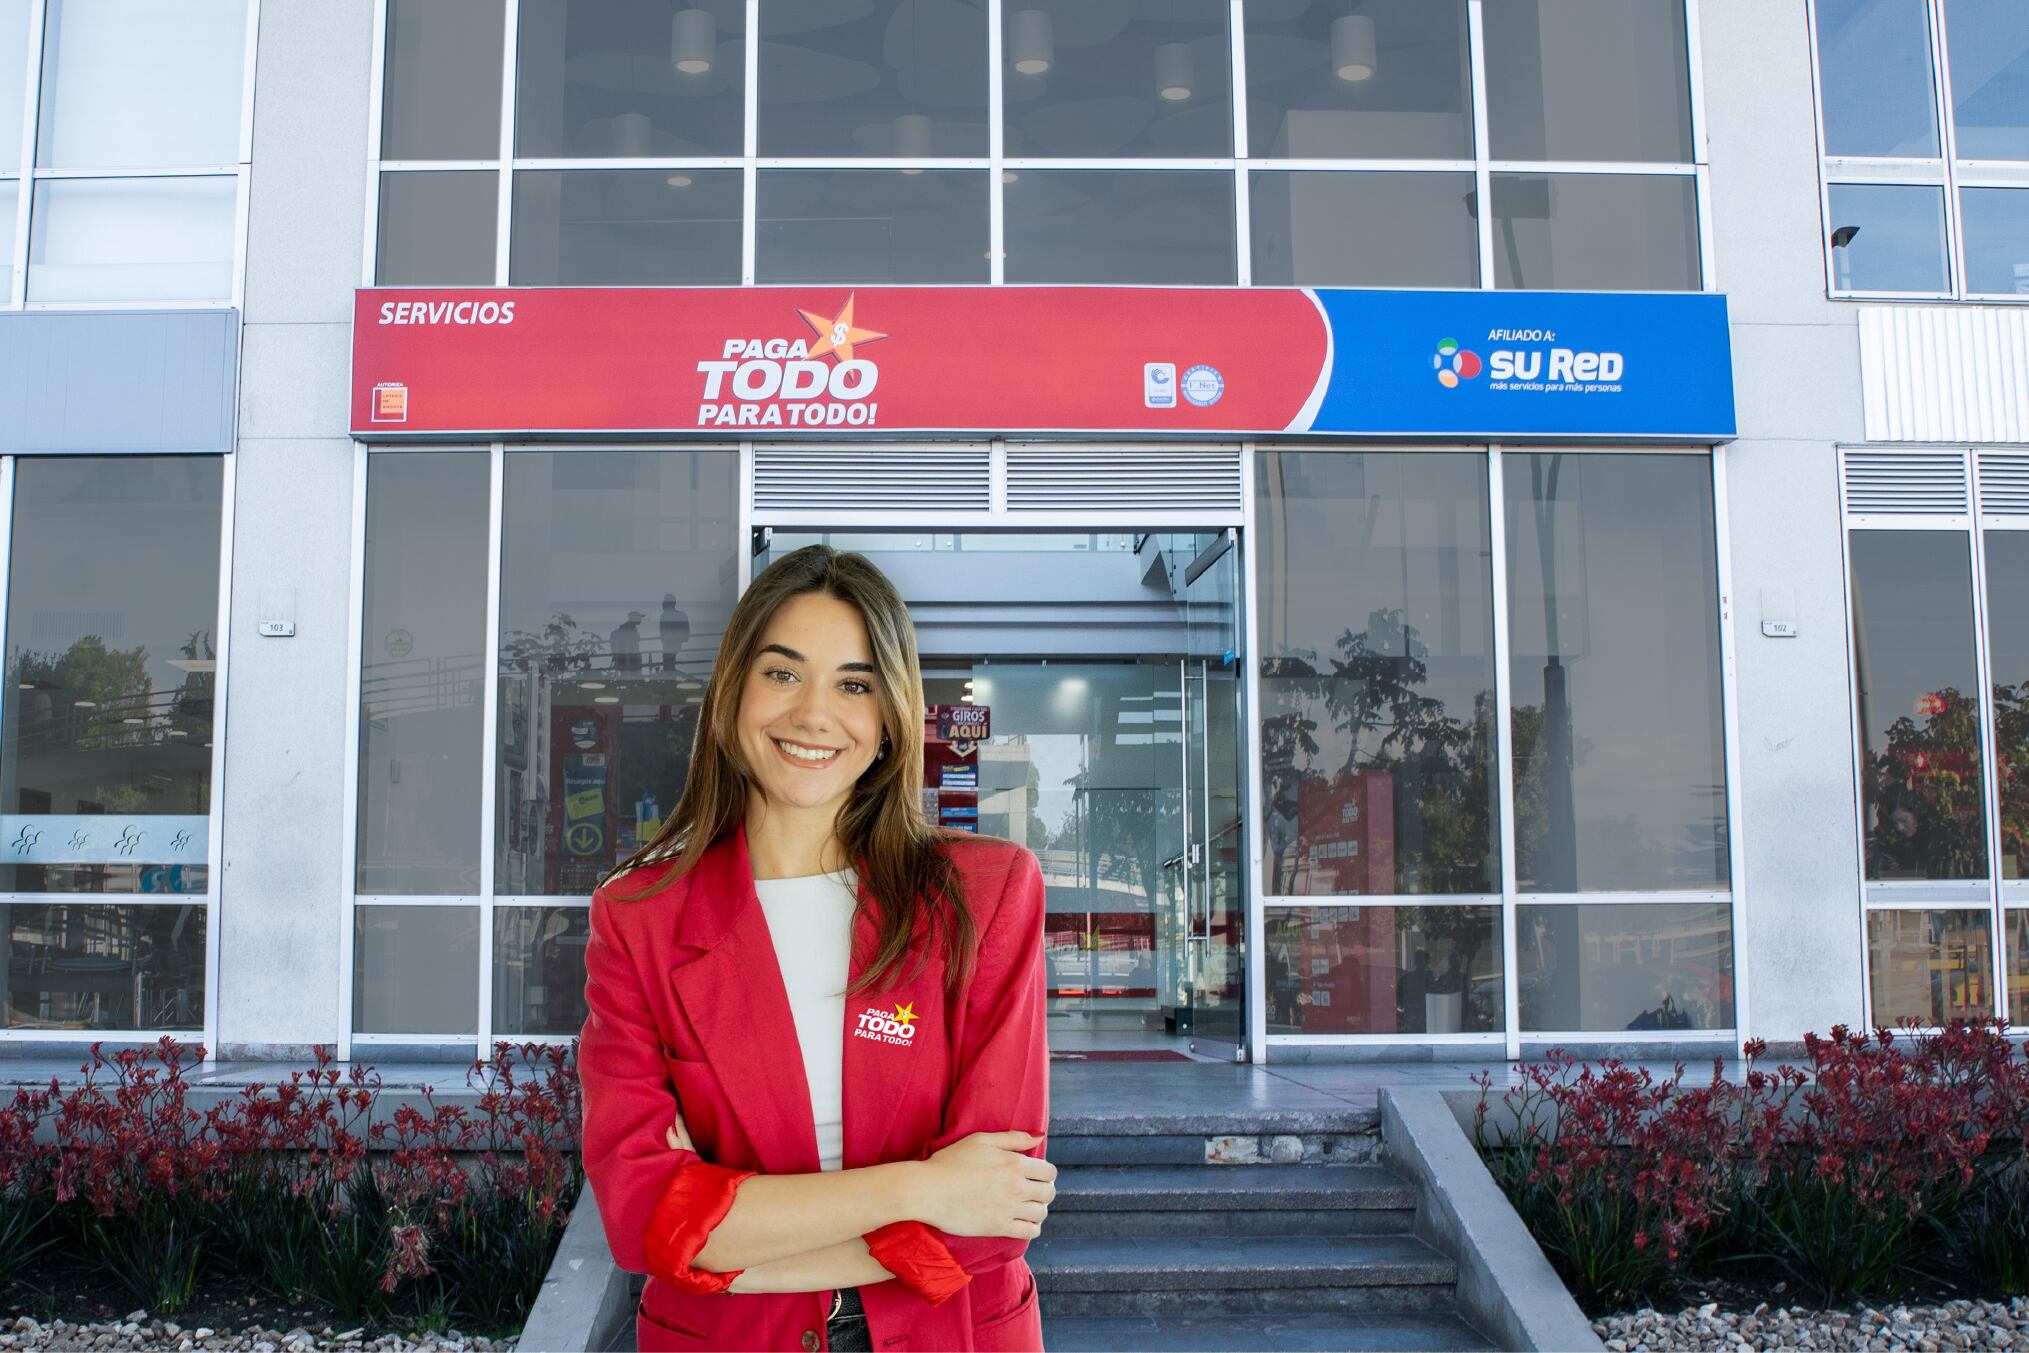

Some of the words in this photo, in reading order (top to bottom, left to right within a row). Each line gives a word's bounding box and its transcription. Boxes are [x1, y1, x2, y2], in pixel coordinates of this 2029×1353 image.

[379, 301, 515, 324] SERVICIOS
[1488, 329, 1541, 341] AFILIADO
[1543, 330, 1555, 341] A:
[723, 339, 808, 359] PAGA
[697, 359, 878, 400] TODO
[1490, 382, 1508, 390] más
[1509, 382, 1544, 391] servicios
[1545, 383, 1563, 393] para
[1565, 382, 1583, 391] más
[1585, 384, 1622, 393] personas
[697, 404, 783, 425] PARA
[786, 403, 878, 425] TODO!
[1774, 624, 1787, 632] 102
[952, 711, 985, 722] GIROS
[949, 723, 988, 738] AQUÍ
[866, 1008, 895, 1019] PAGA
[858, 1014, 915, 1038] TODO
[854, 1028, 881, 1041] PARA
[883, 1035, 912, 1047] TODO!
